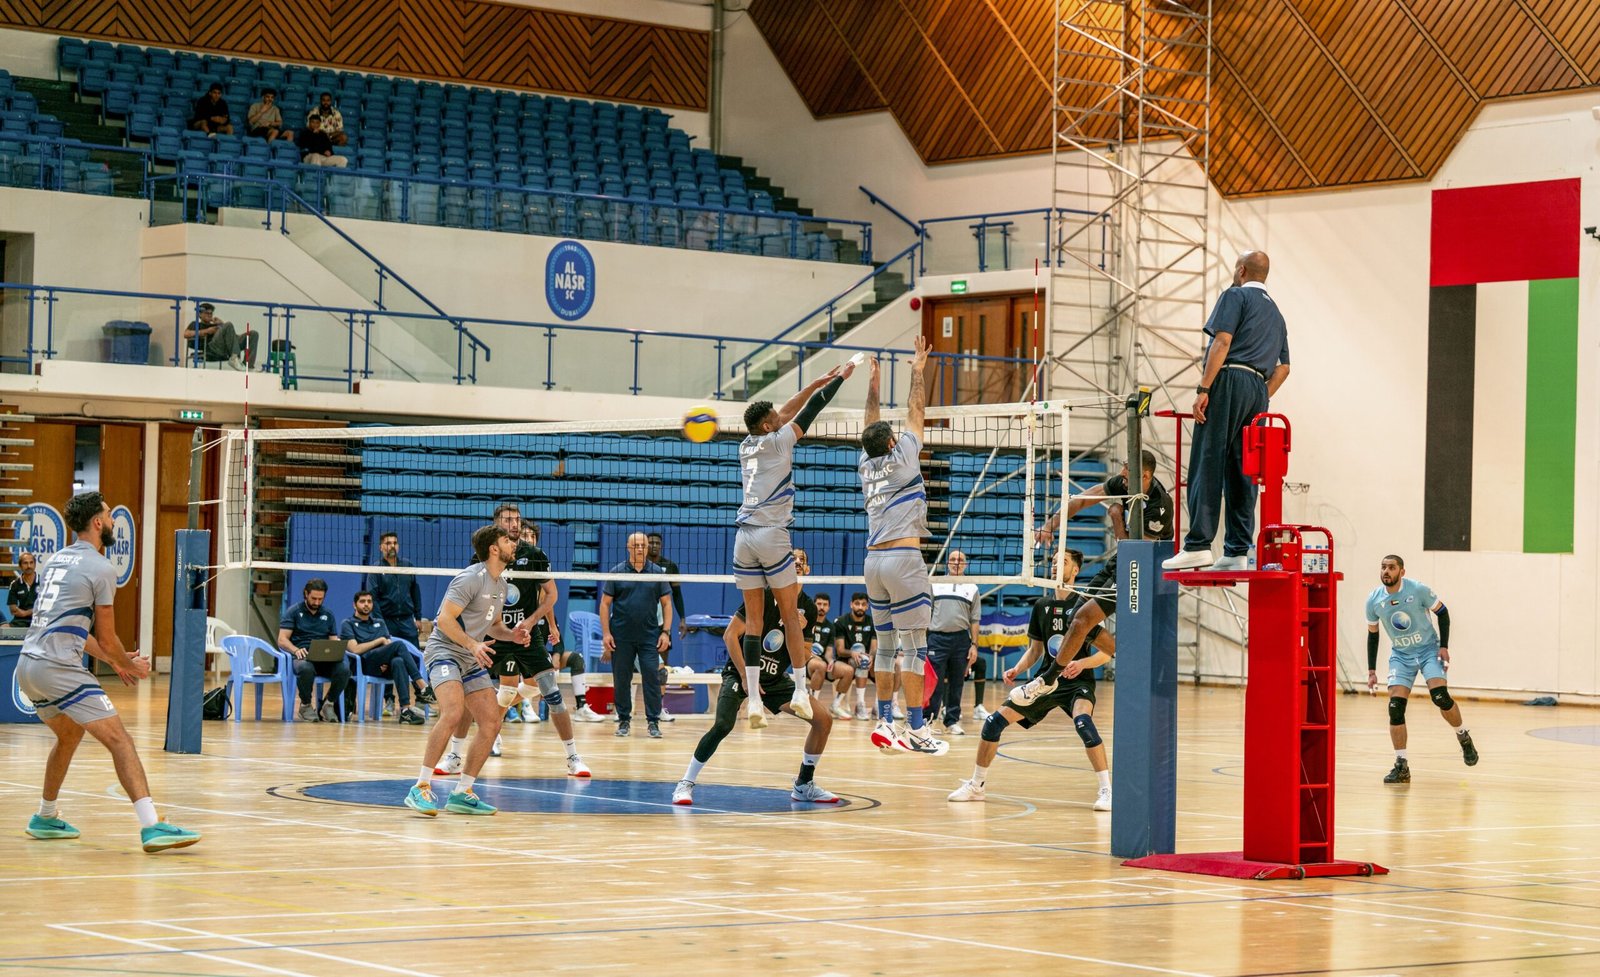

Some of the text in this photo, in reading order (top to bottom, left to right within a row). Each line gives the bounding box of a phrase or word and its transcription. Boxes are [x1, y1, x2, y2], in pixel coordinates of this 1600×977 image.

[565, 261, 576, 274] AL
[555, 273, 585, 291] NASR
[565, 290, 575, 300] SC
[746, 458, 758, 494] 7
[33, 525, 45, 537] AL
[117, 527, 124, 539] AL
[111, 540, 129, 555] NASR
[38, 567, 68, 613] 15
[1130, 561, 1138, 612] PORTER
[1053, 618, 1063, 631] 30
[1394, 633, 1422, 647] ADIB
[506, 661, 515, 672] 17
[732, 682, 739, 692] 4
[100, 695, 114, 711] 15
